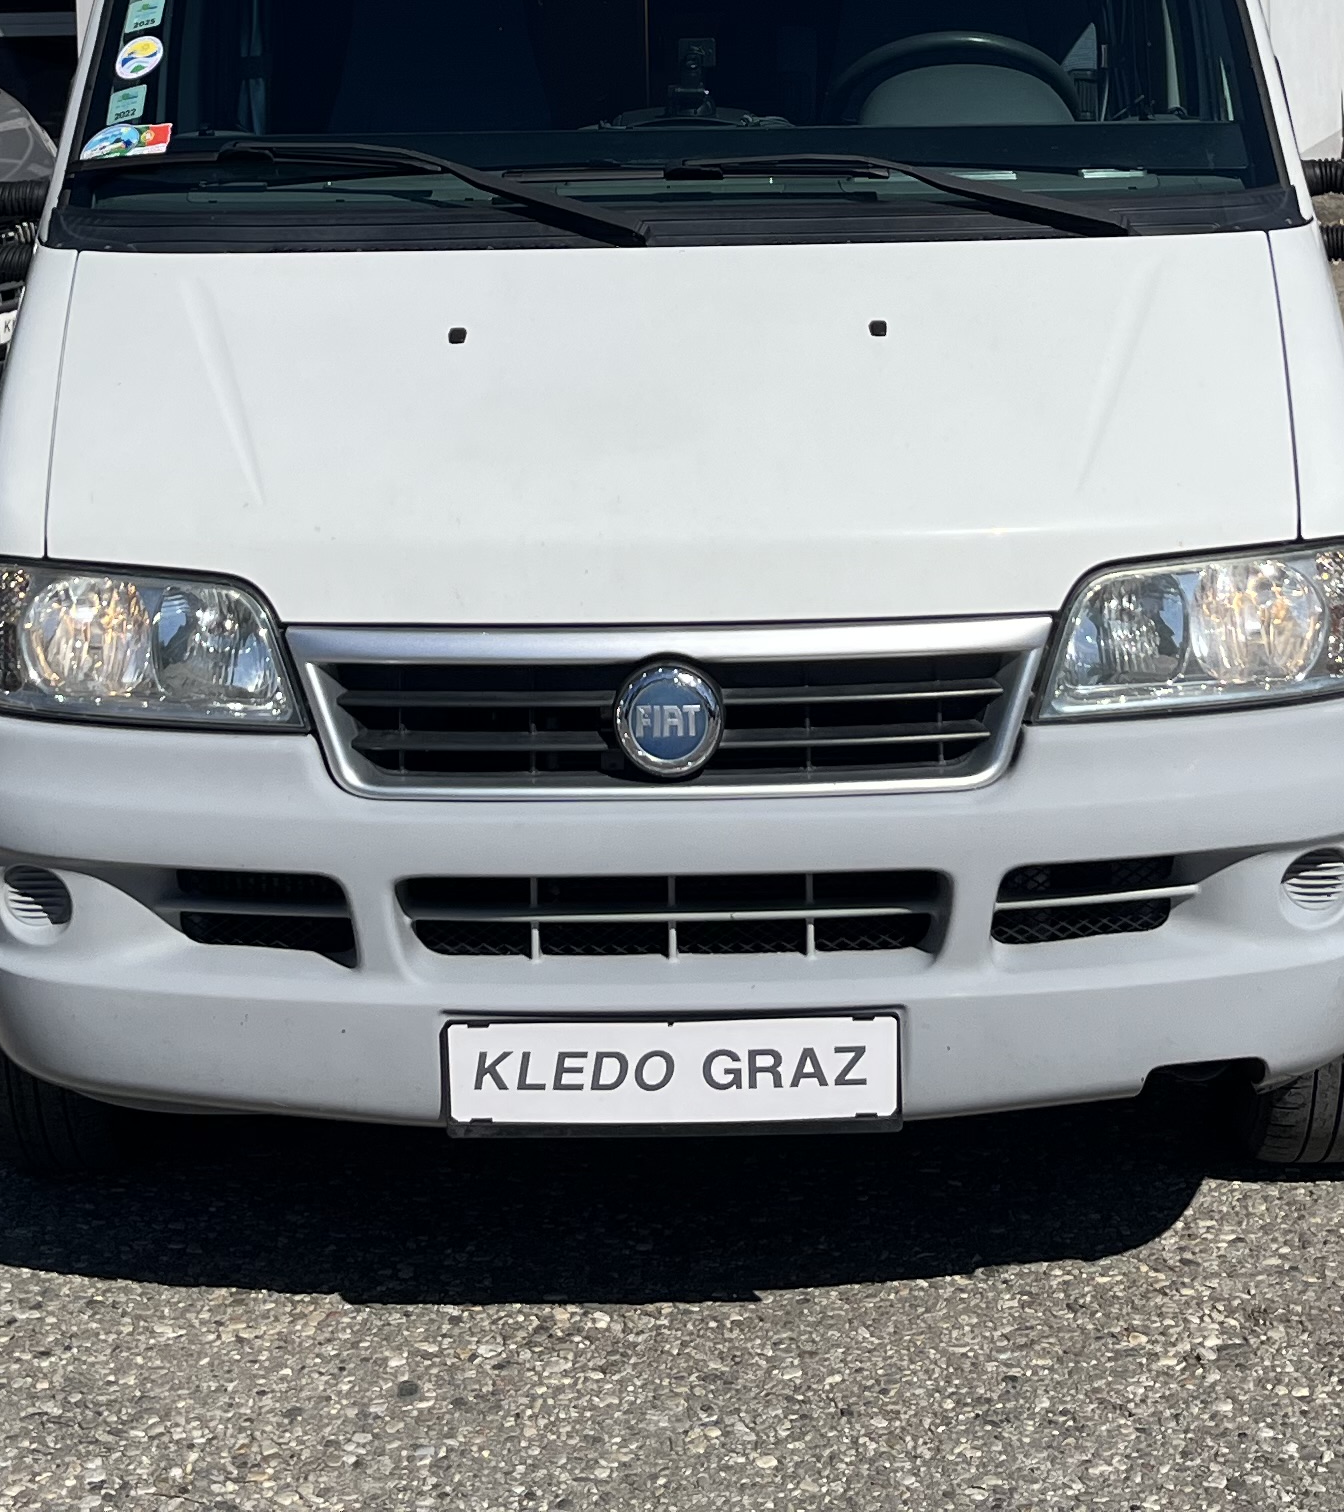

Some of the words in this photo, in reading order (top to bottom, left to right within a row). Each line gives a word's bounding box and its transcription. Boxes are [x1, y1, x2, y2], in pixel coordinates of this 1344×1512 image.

[133, 18, 156, 29] 2025
[114, 108, 137, 120] 2022
[636, 704, 701, 738] FIAT
[474, 1049, 675, 1092] KLEDO
[702, 1045, 867, 1090] GRAZ
